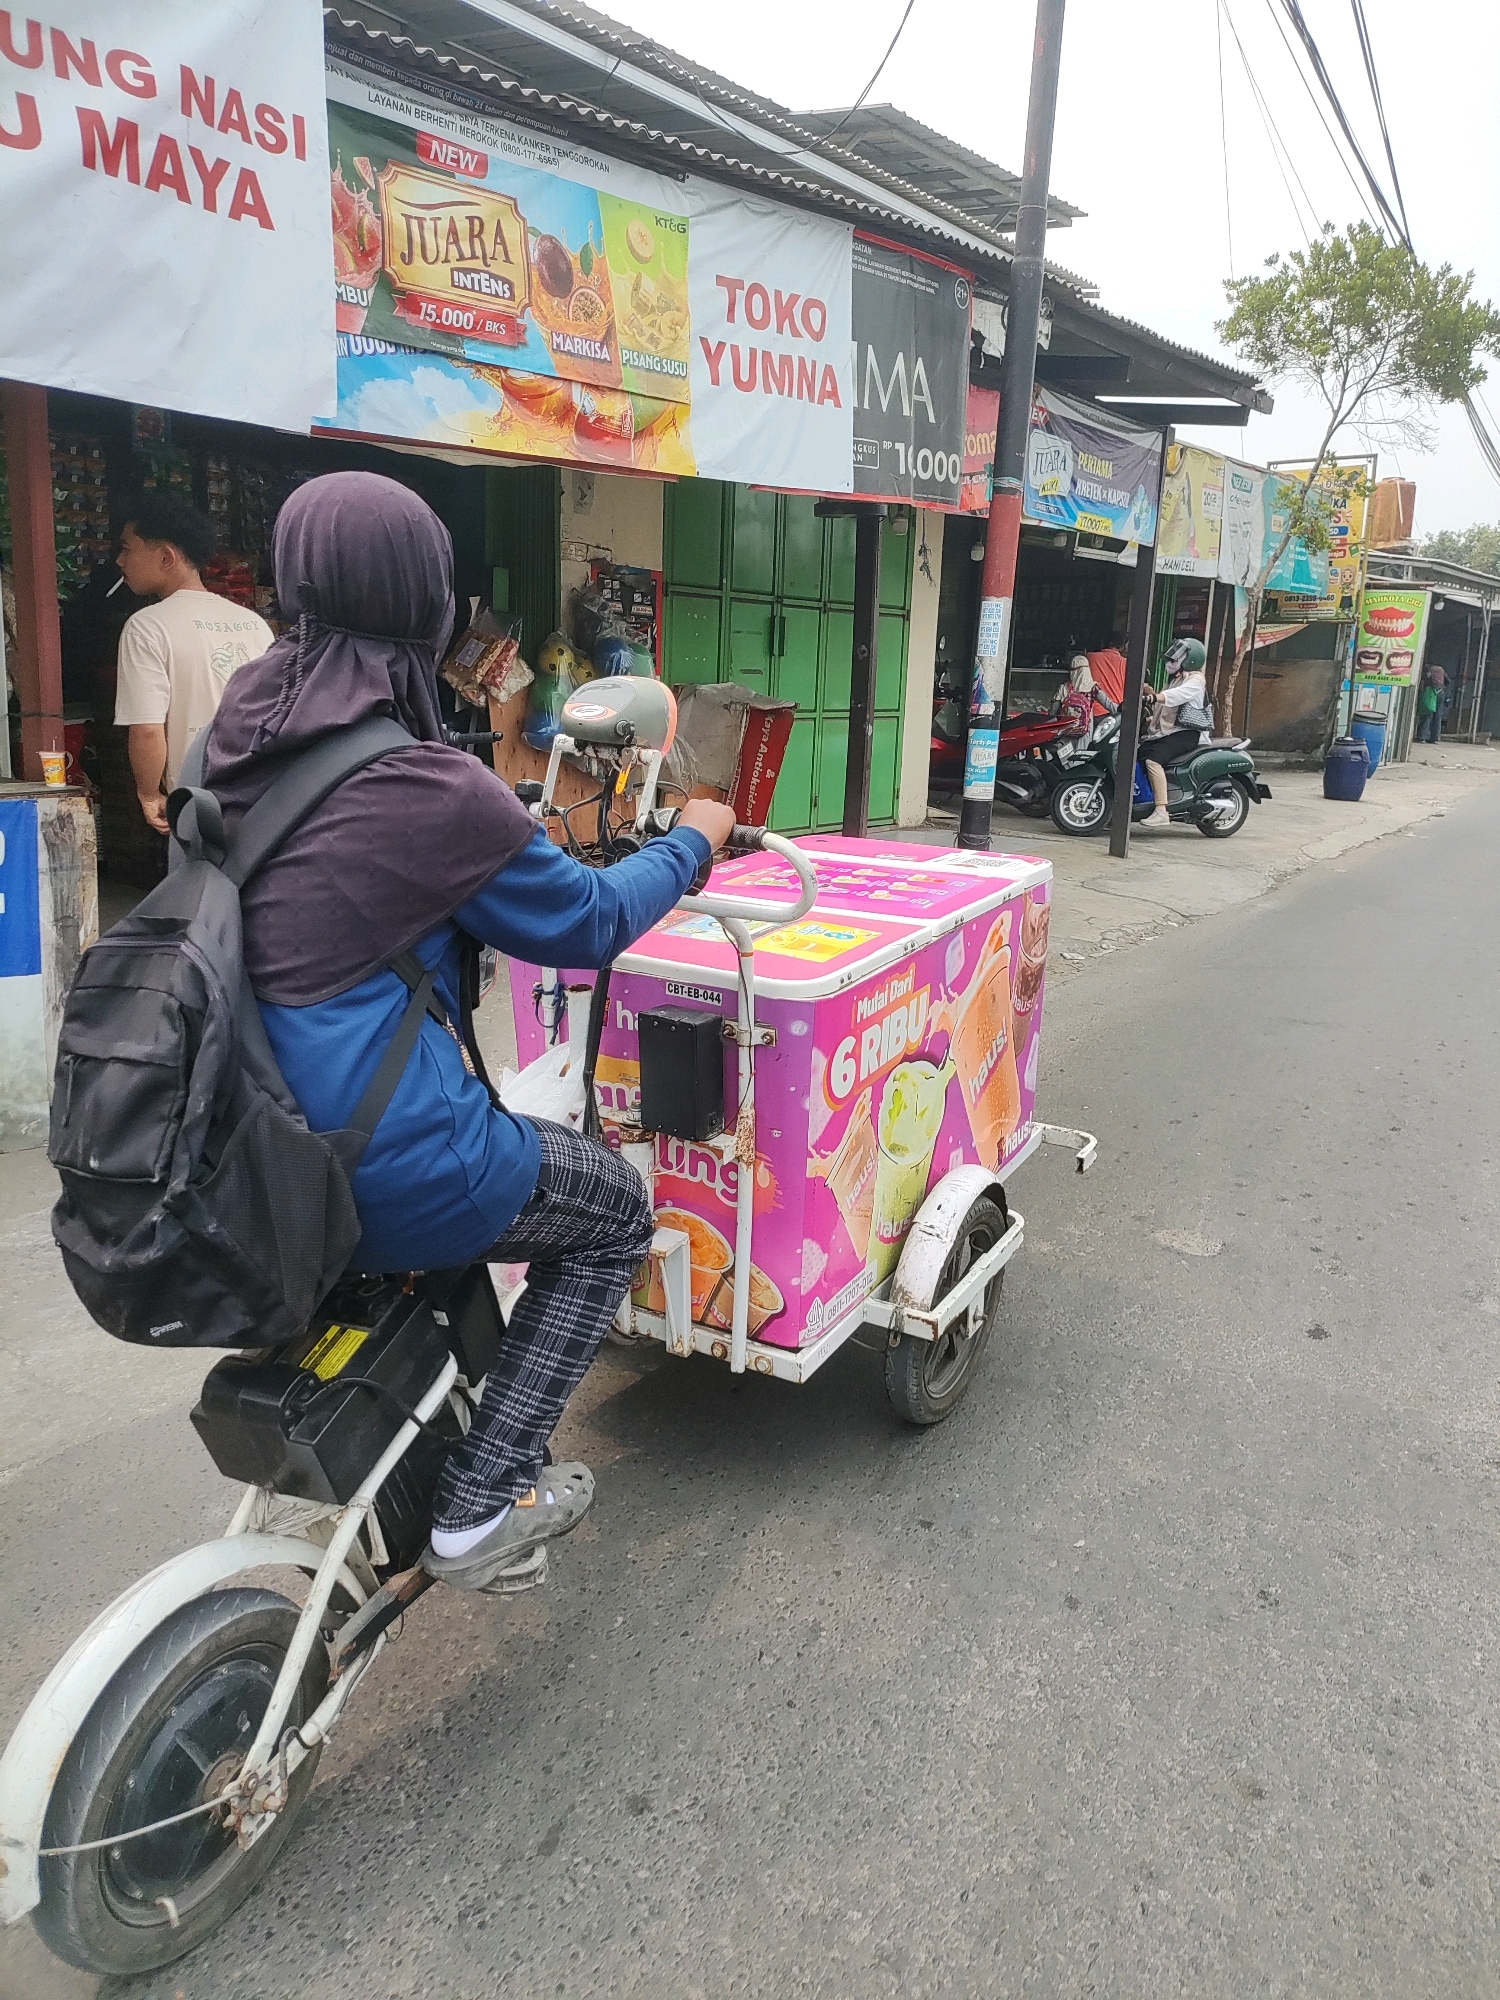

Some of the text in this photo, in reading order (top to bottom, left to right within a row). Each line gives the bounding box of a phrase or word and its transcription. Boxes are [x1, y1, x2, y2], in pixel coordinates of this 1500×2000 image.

[325, 41, 348, 57] njual
[349, 51, 363, 64] dan
[180, 63, 307, 162] NASI
[368, 90, 412, 117] LAYANAN
[414, 107, 457, 133] BERHENTI
[459, 125, 500, 149] MEROKOK
[429, 138, 479, 174] NEW
[480, 117, 517, 142] TERKENA
[517, 134, 551, 153] KANKER
[552, 146, 610, 174] TENGGOROKAN
[75, 105, 276, 232] MAYA
[400, 212, 515, 268] JUARA
[655, 215, 687, 234] KT&G
[715, 273, 827, 342] TOKO
[485, 320, 507, 335] BKS
[552, 331, 611, 362] MARKISA
[622, 348, 688, 378] PISANG SUSU
[699, 335, 842, 409] YUMNA
[883, 440, 893, 450] RP
[1033, 449, 1067, 476] JUARA
[1078, 450, 1113, 479] PERTAMA
[1075, 478, 1102, 502] KRETEK
[1365, 595, 1405, 605] MAHKOTA
[667, 982, 722, 1004] CBT-EB-044
[856, 969, 914, 1023] Mulai Dari
[830, 989, 930, 1099] 6 RIBU
[968, 1016, 1009, 1097] haus!
[1005, 1111, 1034, 1158] haus!
